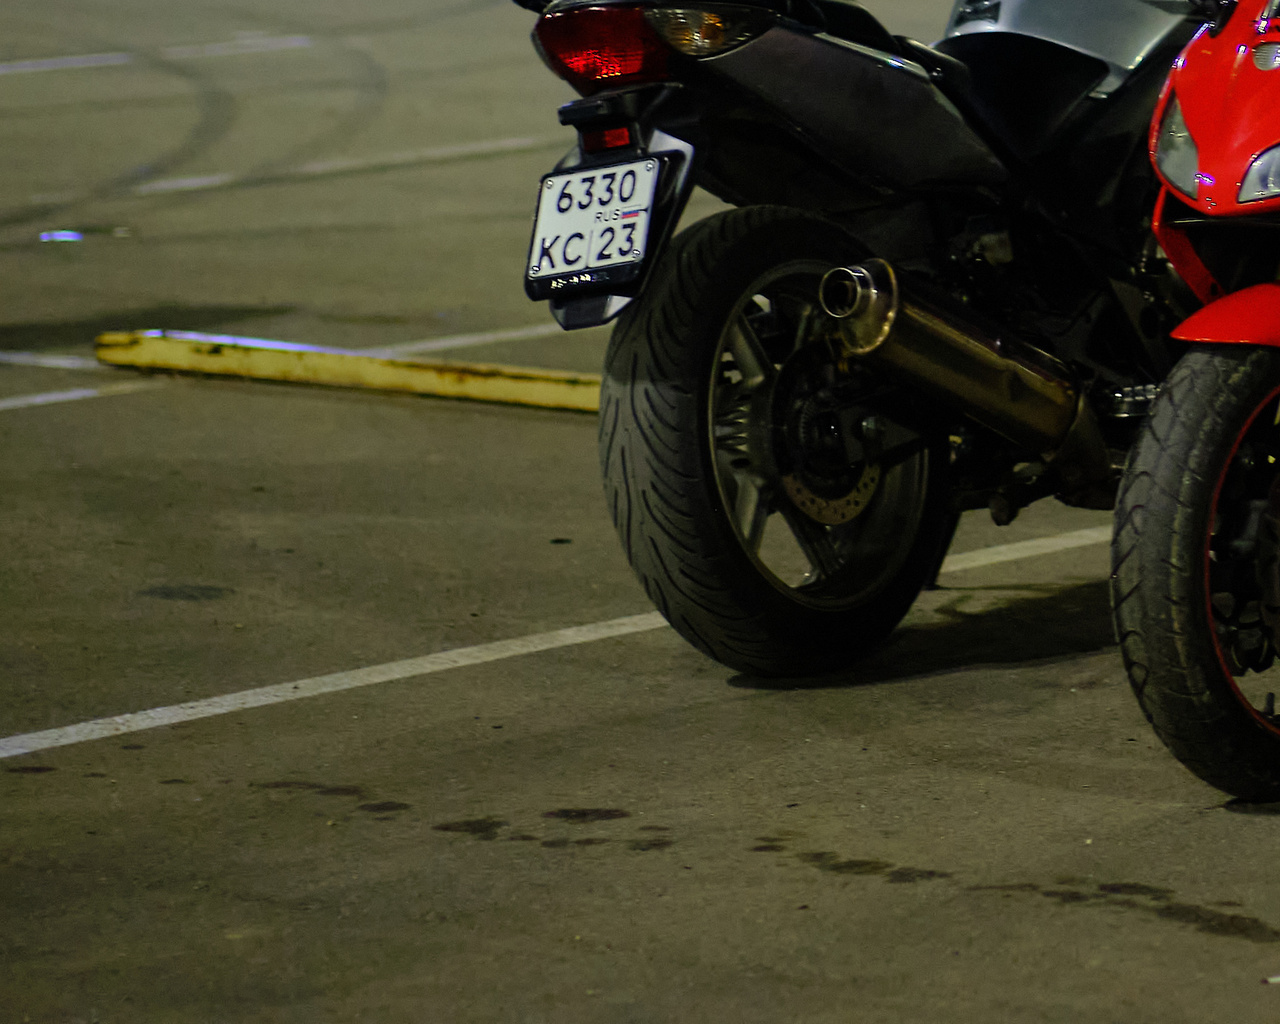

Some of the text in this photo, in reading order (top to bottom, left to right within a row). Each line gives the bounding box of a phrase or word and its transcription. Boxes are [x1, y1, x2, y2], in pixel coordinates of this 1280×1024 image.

[557, 169, 636, 214] 6330
[594, 209, 621, 224] RUS
[538, 222, 637, 269] KC 23
